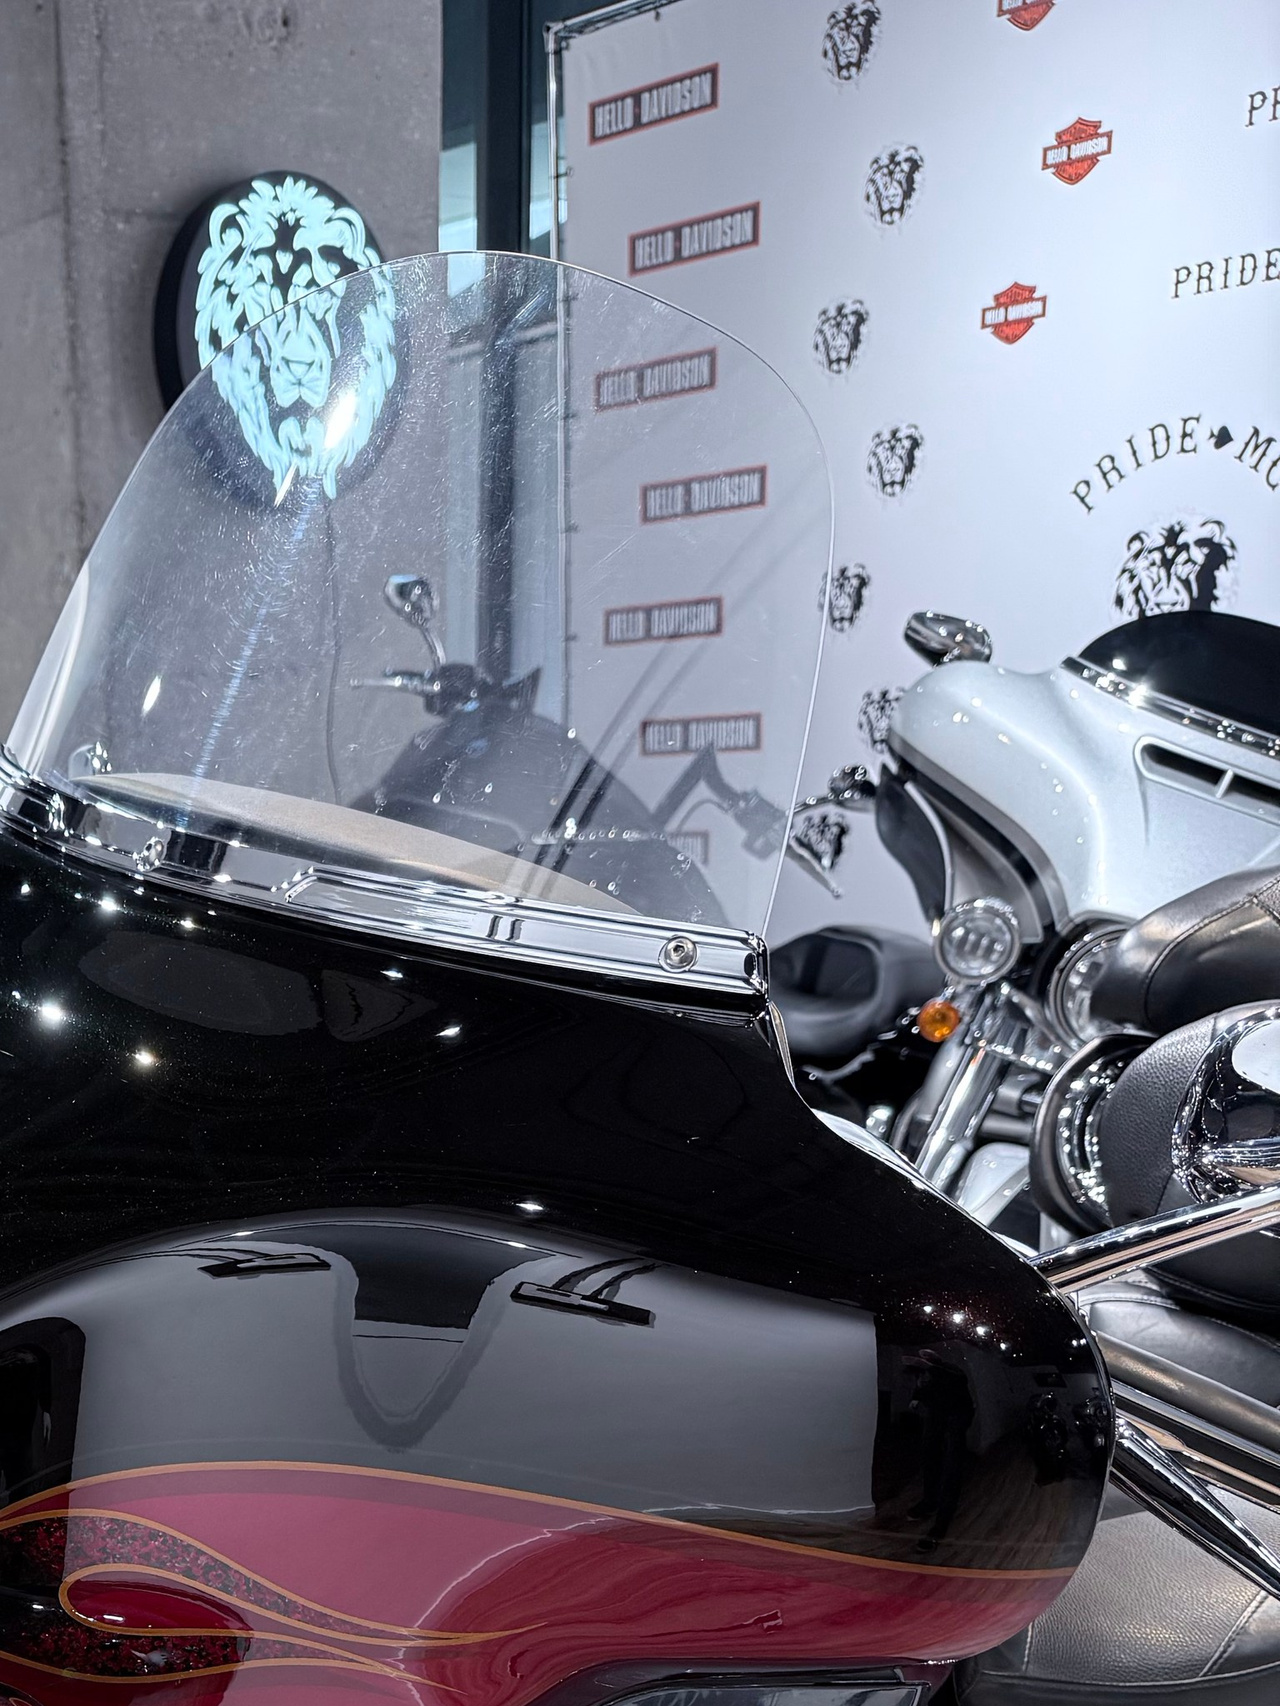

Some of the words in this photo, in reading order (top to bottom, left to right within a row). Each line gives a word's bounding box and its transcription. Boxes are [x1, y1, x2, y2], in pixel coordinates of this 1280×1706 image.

[594, 97, 634, 138] HELLO
[640, 72, 713, 125] DAVIDSON
[634, 230, 675, 270] HELLO
[681, 209, 754, 258] DAVIDSON
[1070, 413, 1202, 515] PRIDE
